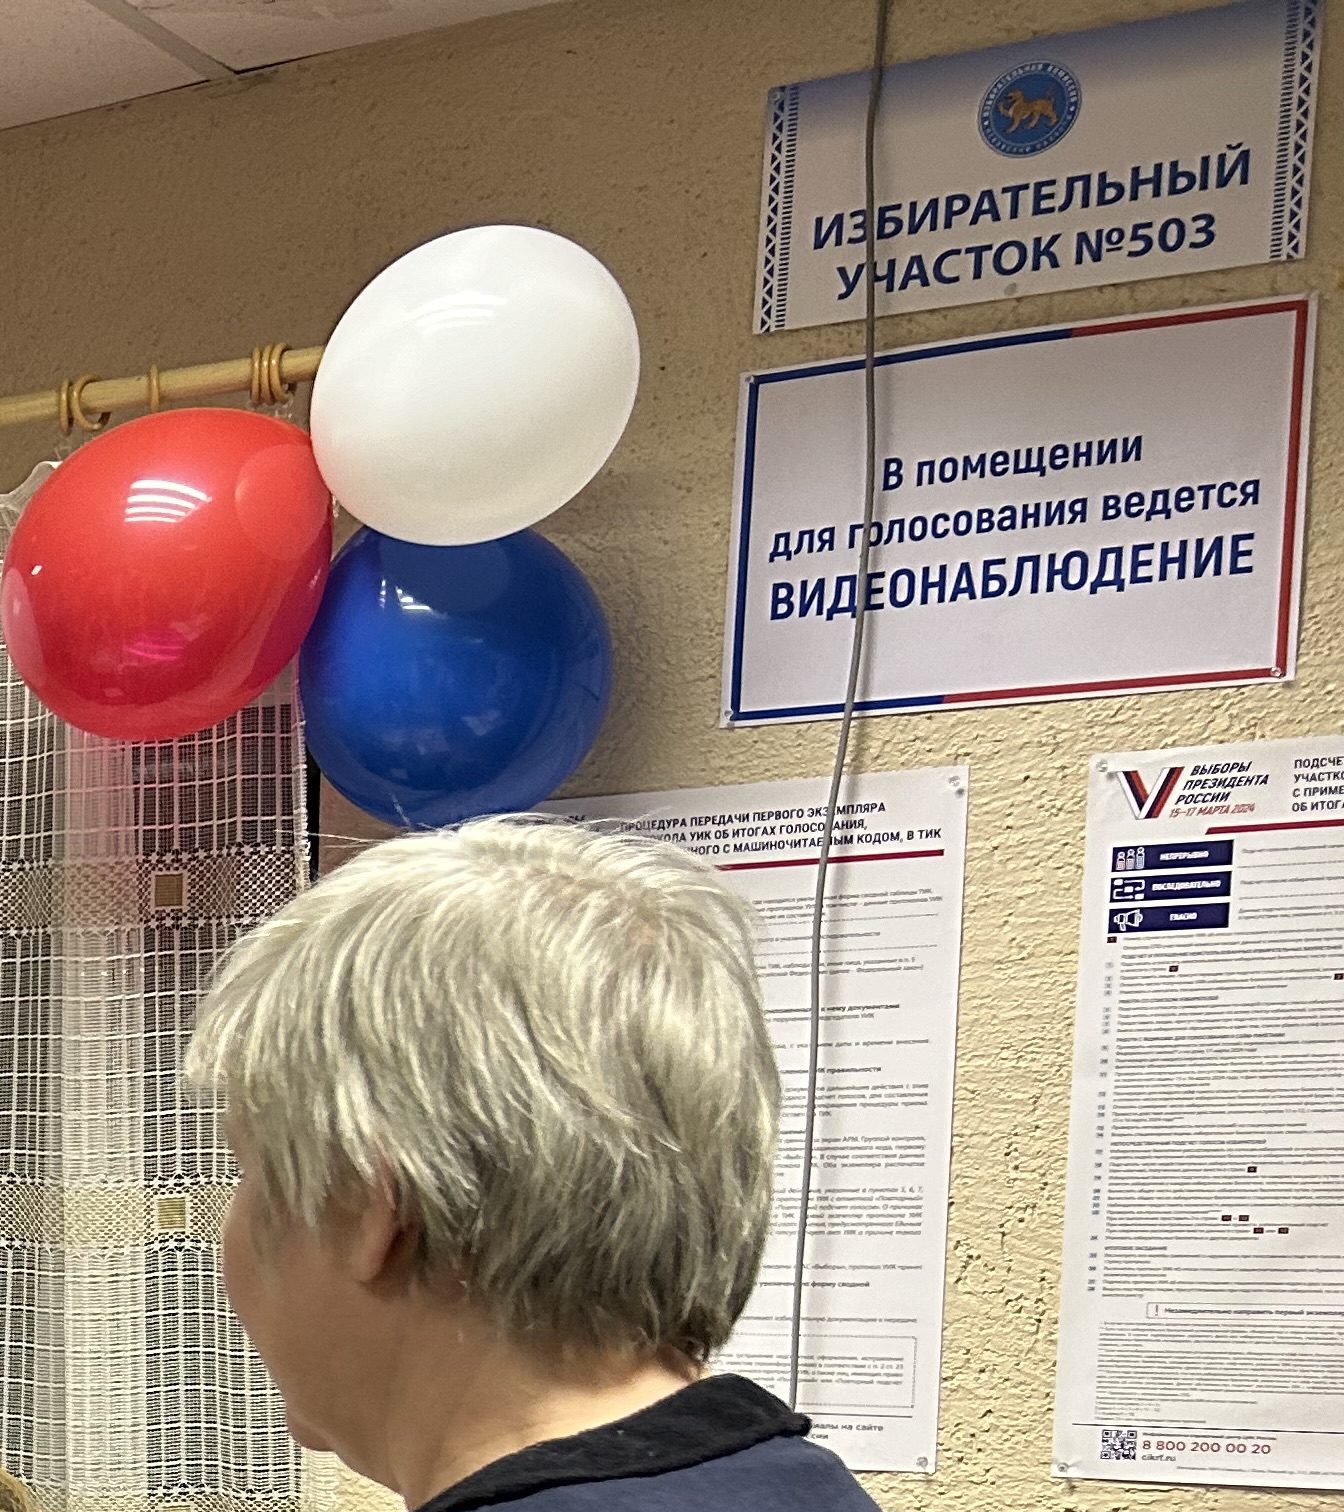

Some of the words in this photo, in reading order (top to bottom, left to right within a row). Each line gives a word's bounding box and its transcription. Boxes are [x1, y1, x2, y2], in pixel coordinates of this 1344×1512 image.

[812, 142, 1252, 250] ИЗБИРАТЕЛЬНЫЙ
[836, 233, 1062, 300] УЧАСТОК
[1074, 213, 1217, 266] №503
[882, 457, 904, 491] В
[915, 435, 1144, 488] помещении
[768, 526, 836, 563] для
[848, 496, 1087, 550] голосования
[1102, 478, 1262, 522] ведется
[769, 532, 1256, 621] ВИДЕОНАБЛЮДЕНИЕ
[1190, 761, 1252, 776] ВЫБОРЫ
[1182, 774, 1269, 791] ПРЕЗИДЕНТА
[1174, 791, 1231, 805] РОССИИ
[1291, 802, 1308, 812] ОБ
[690, 813, 750, 827] ПЕРЕДАЧИ
[752, 808, 804, 822] ПЕРВОГО
[807, 802, 886, 817] ЭКЗМПЛЯРА
[690, 832, 711, 841] УИК
[714, 829, 730, 839] ОБ
[732, 825, 776, 838] ИТОГАХ
[779, 818, 868, 835] ГОЛОСОАНИЯ,
[723, 843, 730, 854] С
[857, 831, 903, 845] КОДОМ,
[907, 830, 915, 841] В
[918, 828, 942, 840] ТИК
[1142, 1440, 1152, 1450] 8
[1156, 1441, 1185, 1451] 800
[1190, 1442, 1221, 1452] 200
[1225, 1443, 1247, 1453] 00
[1251, 1444, 1272, 1454] 20
